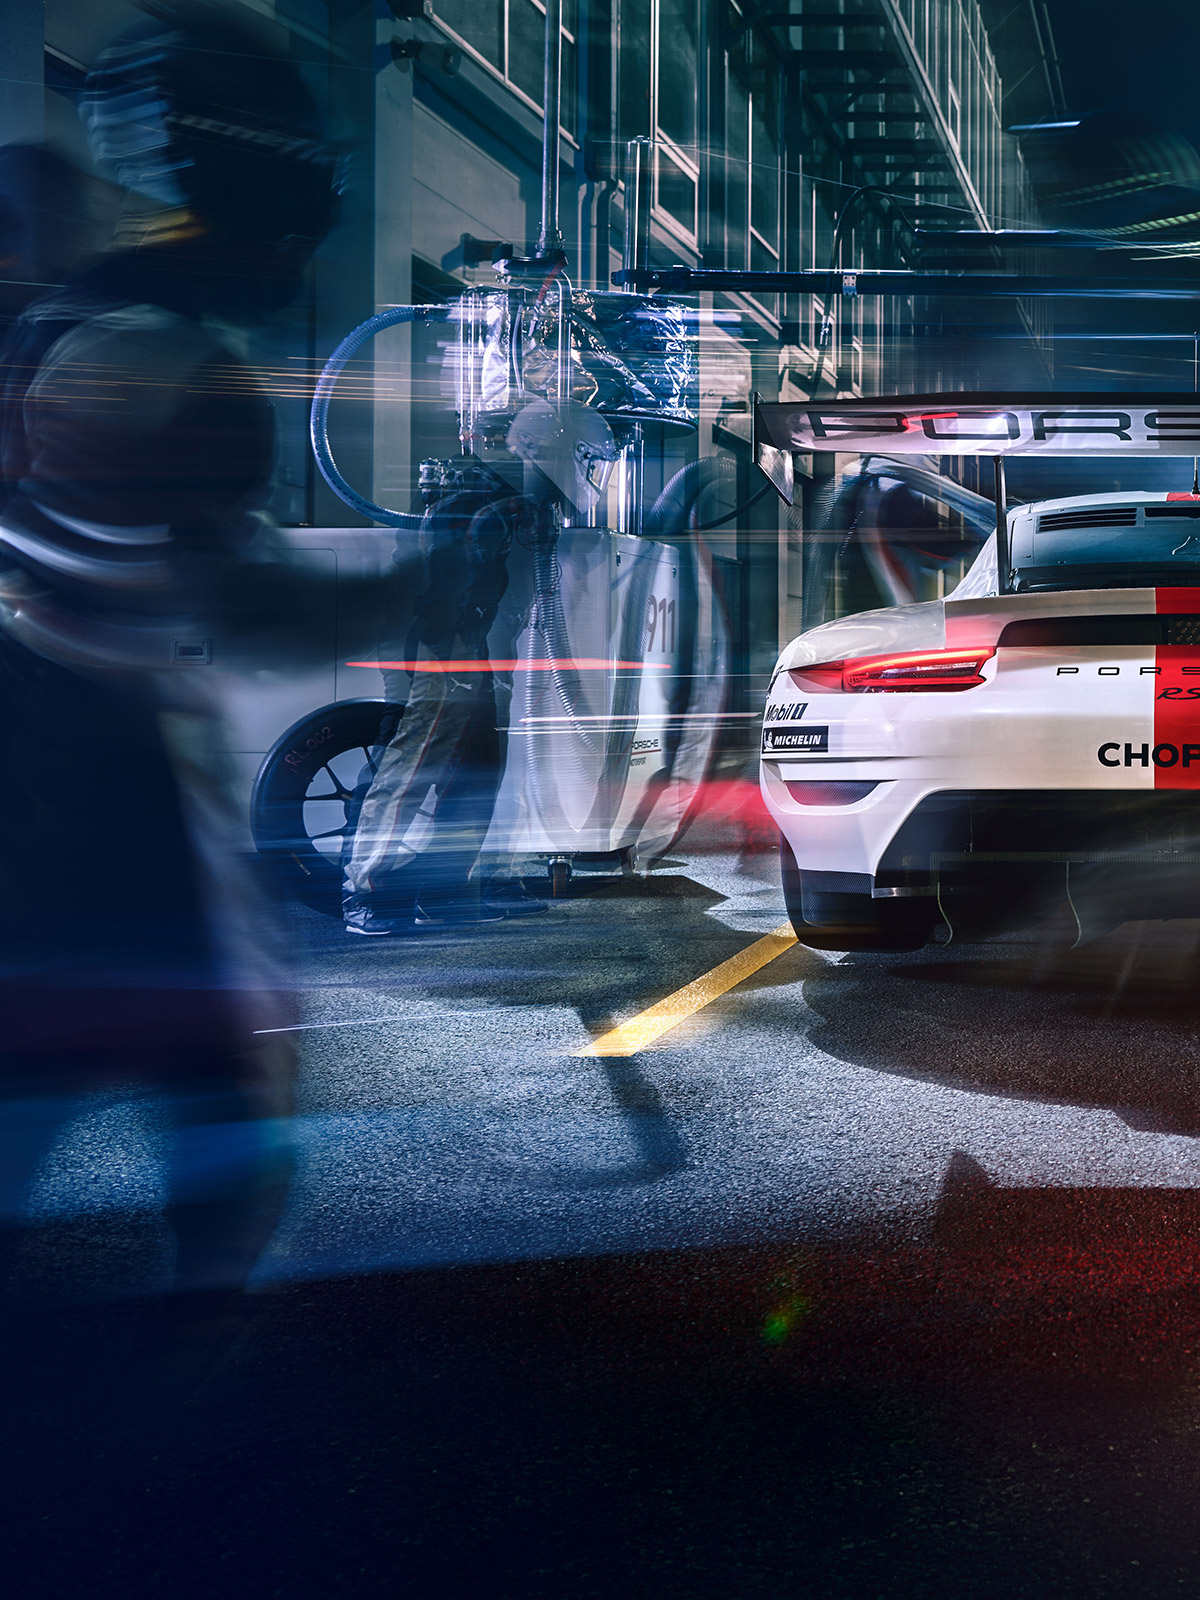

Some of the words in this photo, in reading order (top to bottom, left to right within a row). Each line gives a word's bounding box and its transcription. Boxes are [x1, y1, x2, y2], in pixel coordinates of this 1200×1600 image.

[647, 594, 676, 653] 911
[765, 703, 795, 721] Mobil
[773, 735, 822, 746] MICHELIN
